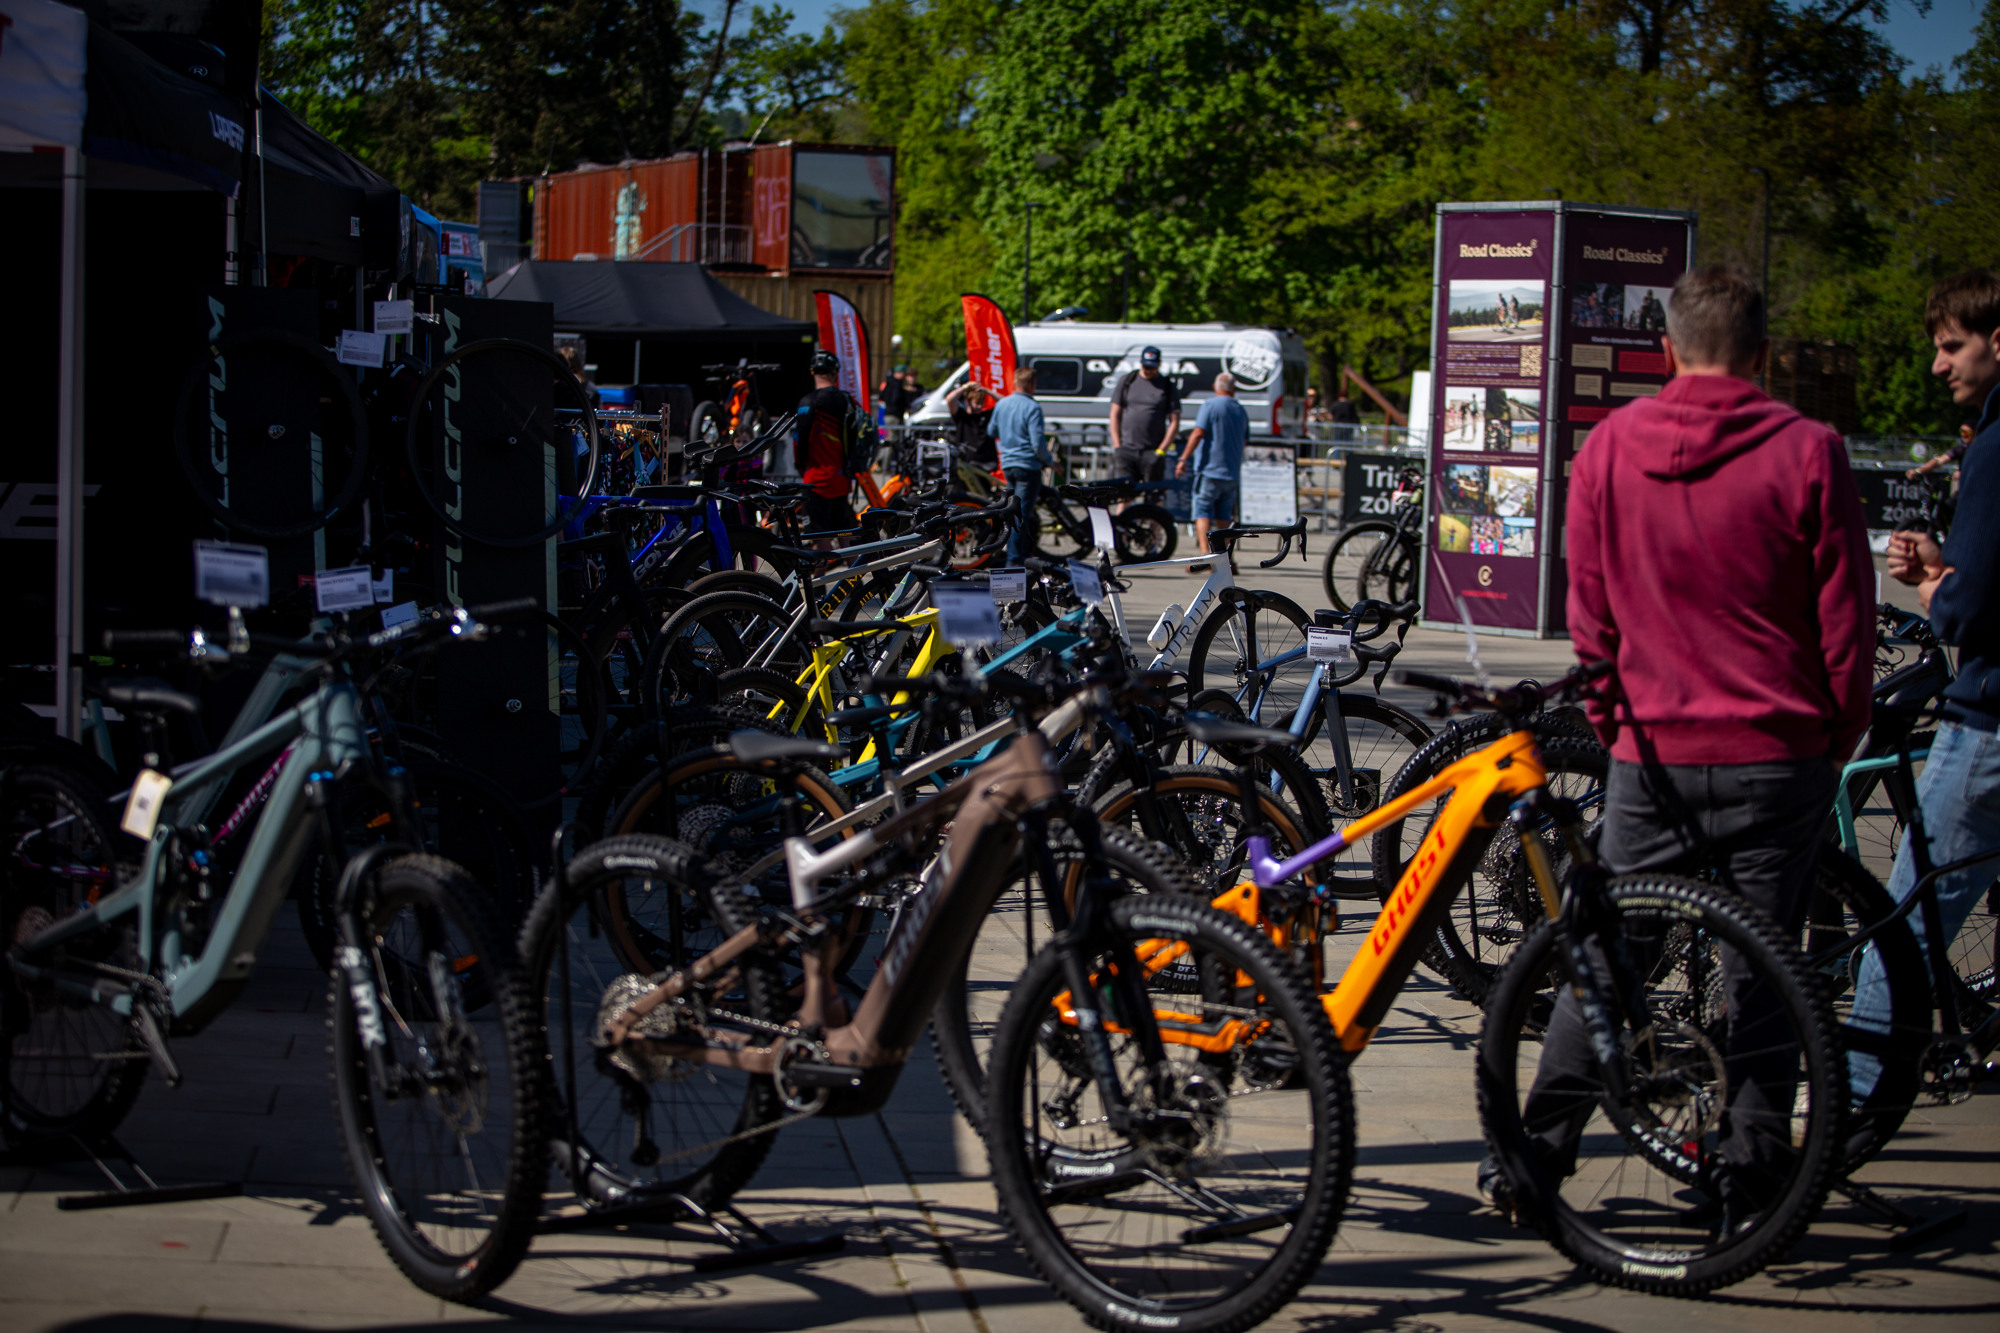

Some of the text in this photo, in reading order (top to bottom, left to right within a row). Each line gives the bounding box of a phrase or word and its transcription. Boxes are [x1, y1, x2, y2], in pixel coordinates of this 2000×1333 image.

[1460, 243, 1488, 257] Road
[1583, 244, 1614, 260] Road
[207, 295, 231, 546] ULCRUM
[1361, 464, 1399, 488] Tri
[1882, 478, 1920, 500] Tria
[1359, 491, 1398, 515] zó
[1881, 501, 1921, 522] zón
[1430, 728, 1489, 764] MAXIS
[226, 754, 288, 833] GHOST
[1372, 829, 1445, 956] GHOST
[1436, 925, 1456, 959] KRYPTOTA
